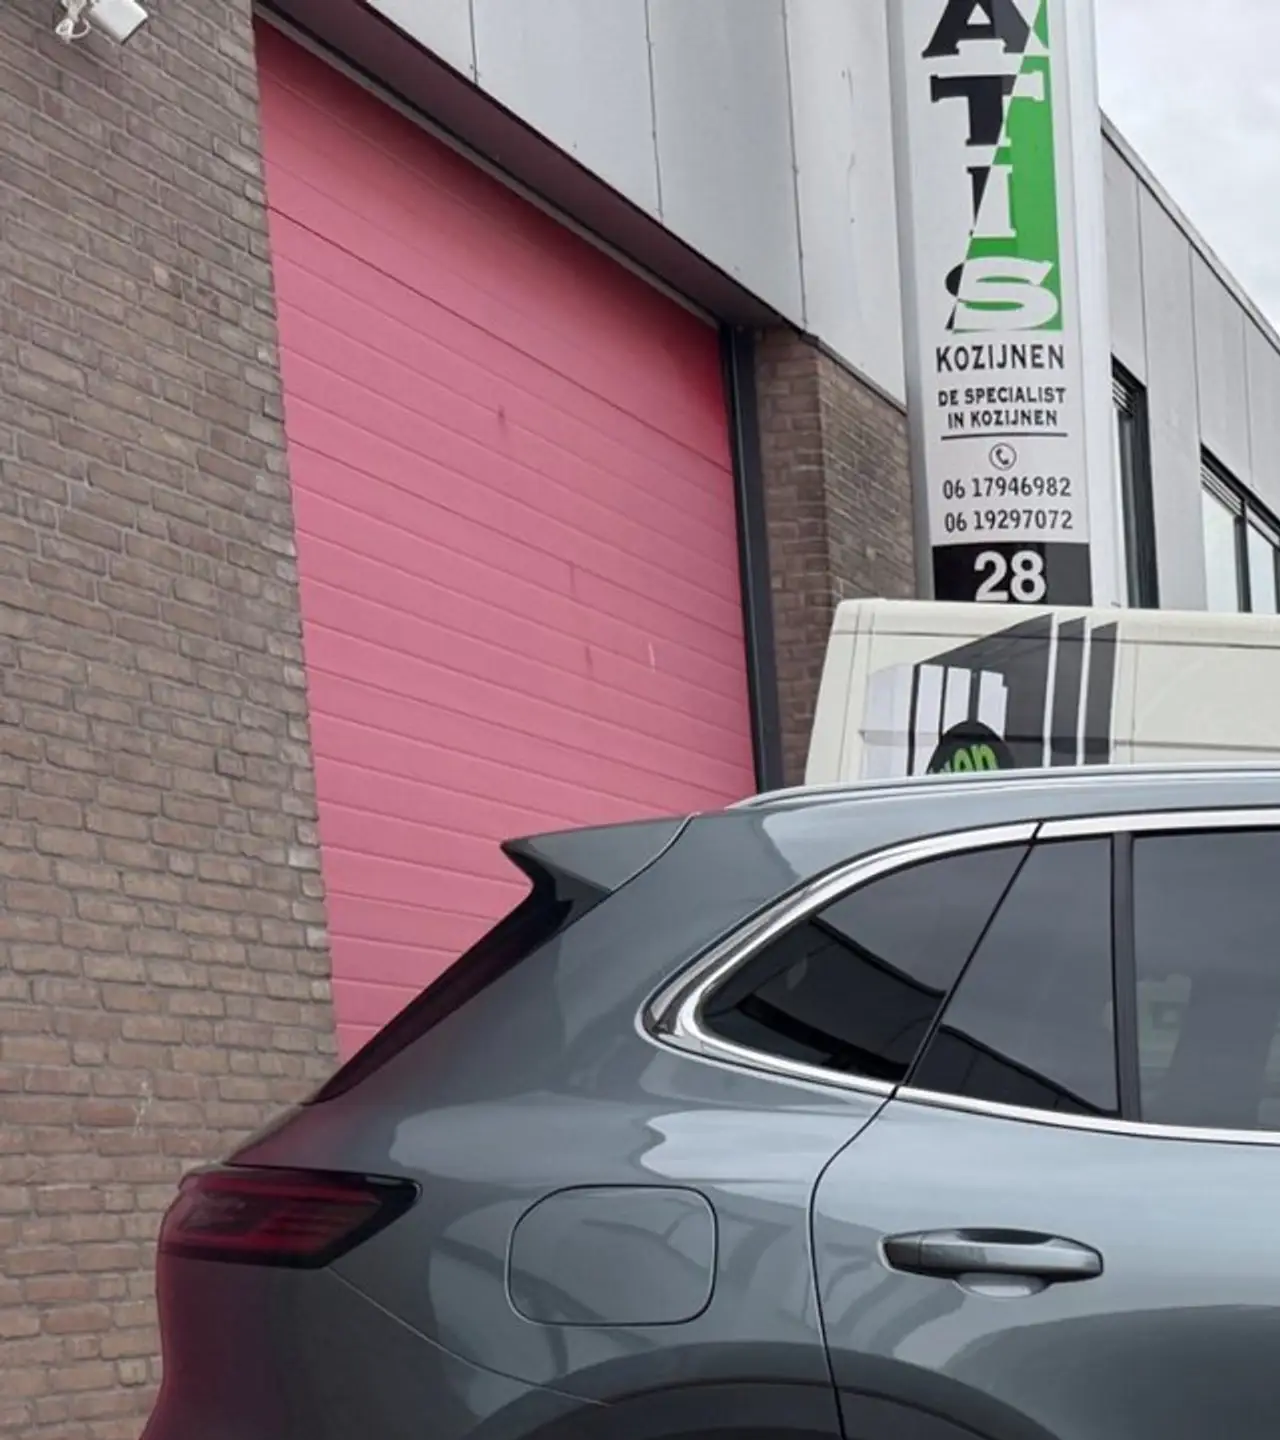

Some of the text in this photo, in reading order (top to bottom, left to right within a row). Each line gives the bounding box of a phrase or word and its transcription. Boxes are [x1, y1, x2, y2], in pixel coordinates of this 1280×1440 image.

[935, 344, 1065, 373] KOZIJNEN
[938, 386, 1067, 407] DE SPECIALIST
[947, 409, 1058, 429] IN KOZIJNEN
[942, 476, 1072, 500] 06 17946982
[944, 509, 1074, 533] 06 19297072
[973, 549, 1047, 603] 28
